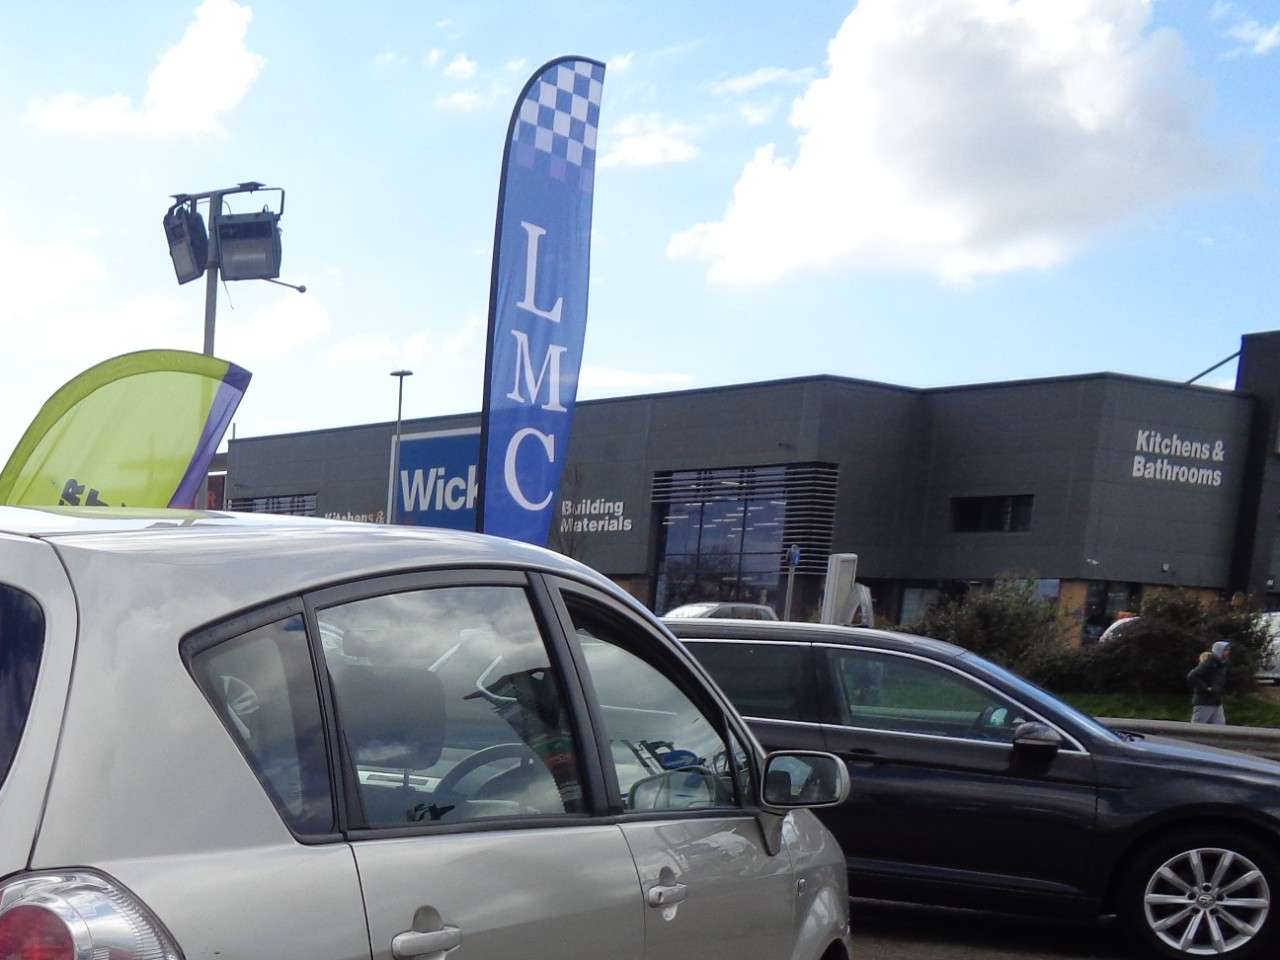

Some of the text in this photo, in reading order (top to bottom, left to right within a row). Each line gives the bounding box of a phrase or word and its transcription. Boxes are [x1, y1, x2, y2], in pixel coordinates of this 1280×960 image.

[504, 220, 568, 511] LMC
[1136, 430, 1225, 461] Kitchens &
[1132, 455, 1223, 486] Bathrooms
[561, 498, 624, 516] Building
[560, 516, 632, 533] Materials
